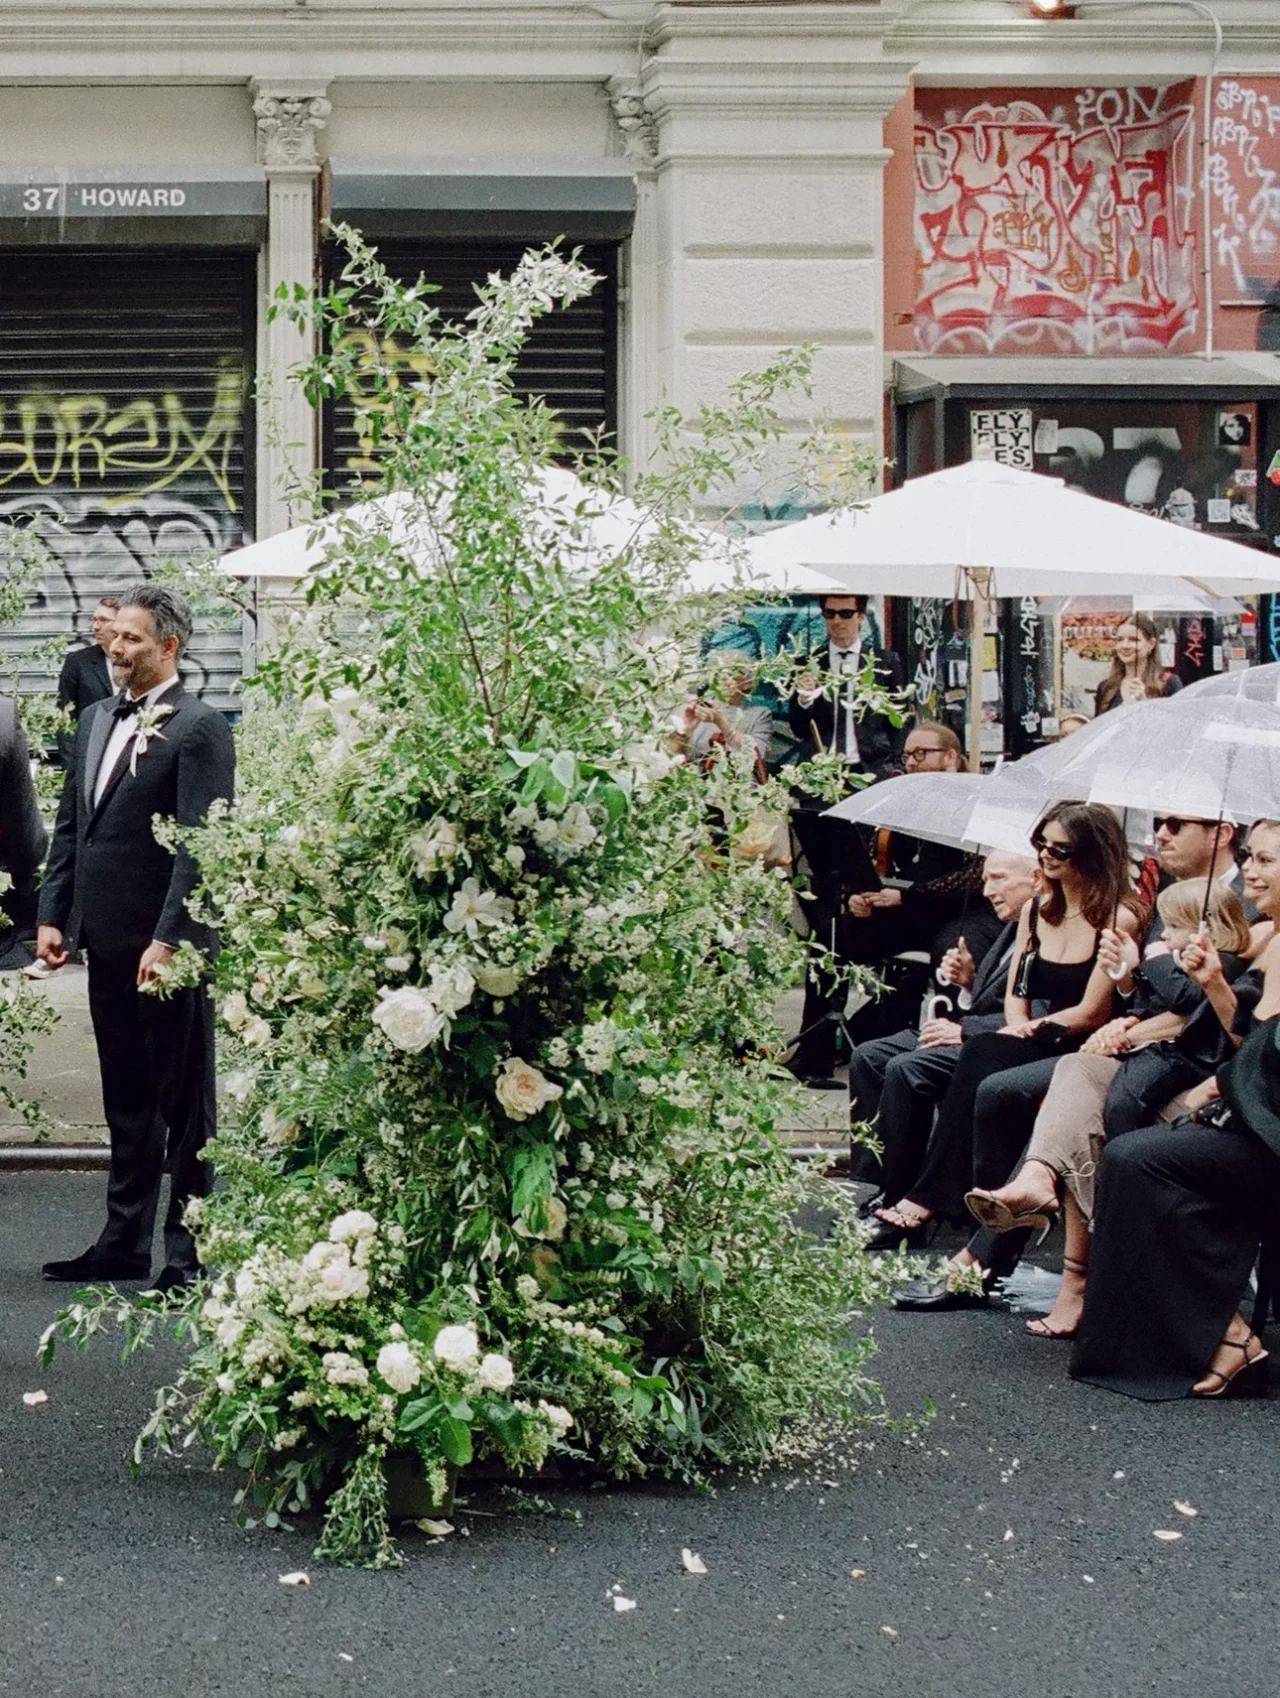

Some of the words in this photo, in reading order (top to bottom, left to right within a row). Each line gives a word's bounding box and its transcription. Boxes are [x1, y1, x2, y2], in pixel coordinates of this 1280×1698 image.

[22, 187, 60, 211] 37
[81, 188, 186, 207] HOWARD
[977, 414, 1023, 430] FLY
